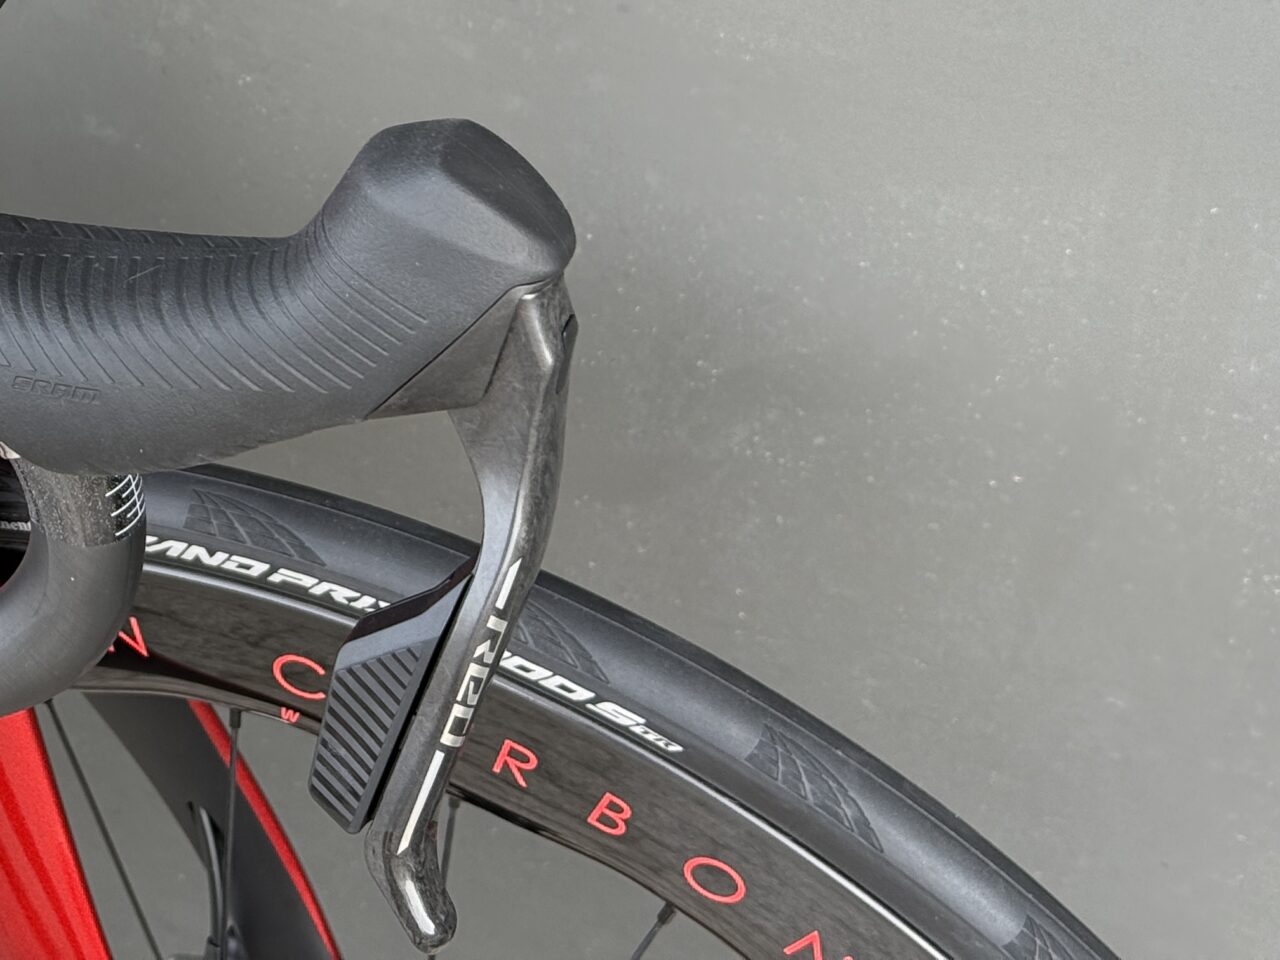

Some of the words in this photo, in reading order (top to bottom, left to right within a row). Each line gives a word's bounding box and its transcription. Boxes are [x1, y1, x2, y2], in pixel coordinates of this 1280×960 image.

[11, 375, 101, 404] SRAM
[145, 535, 270, 578] AND
[584, 700, 647, 726] S
[438, 614, 508, 748] RED
